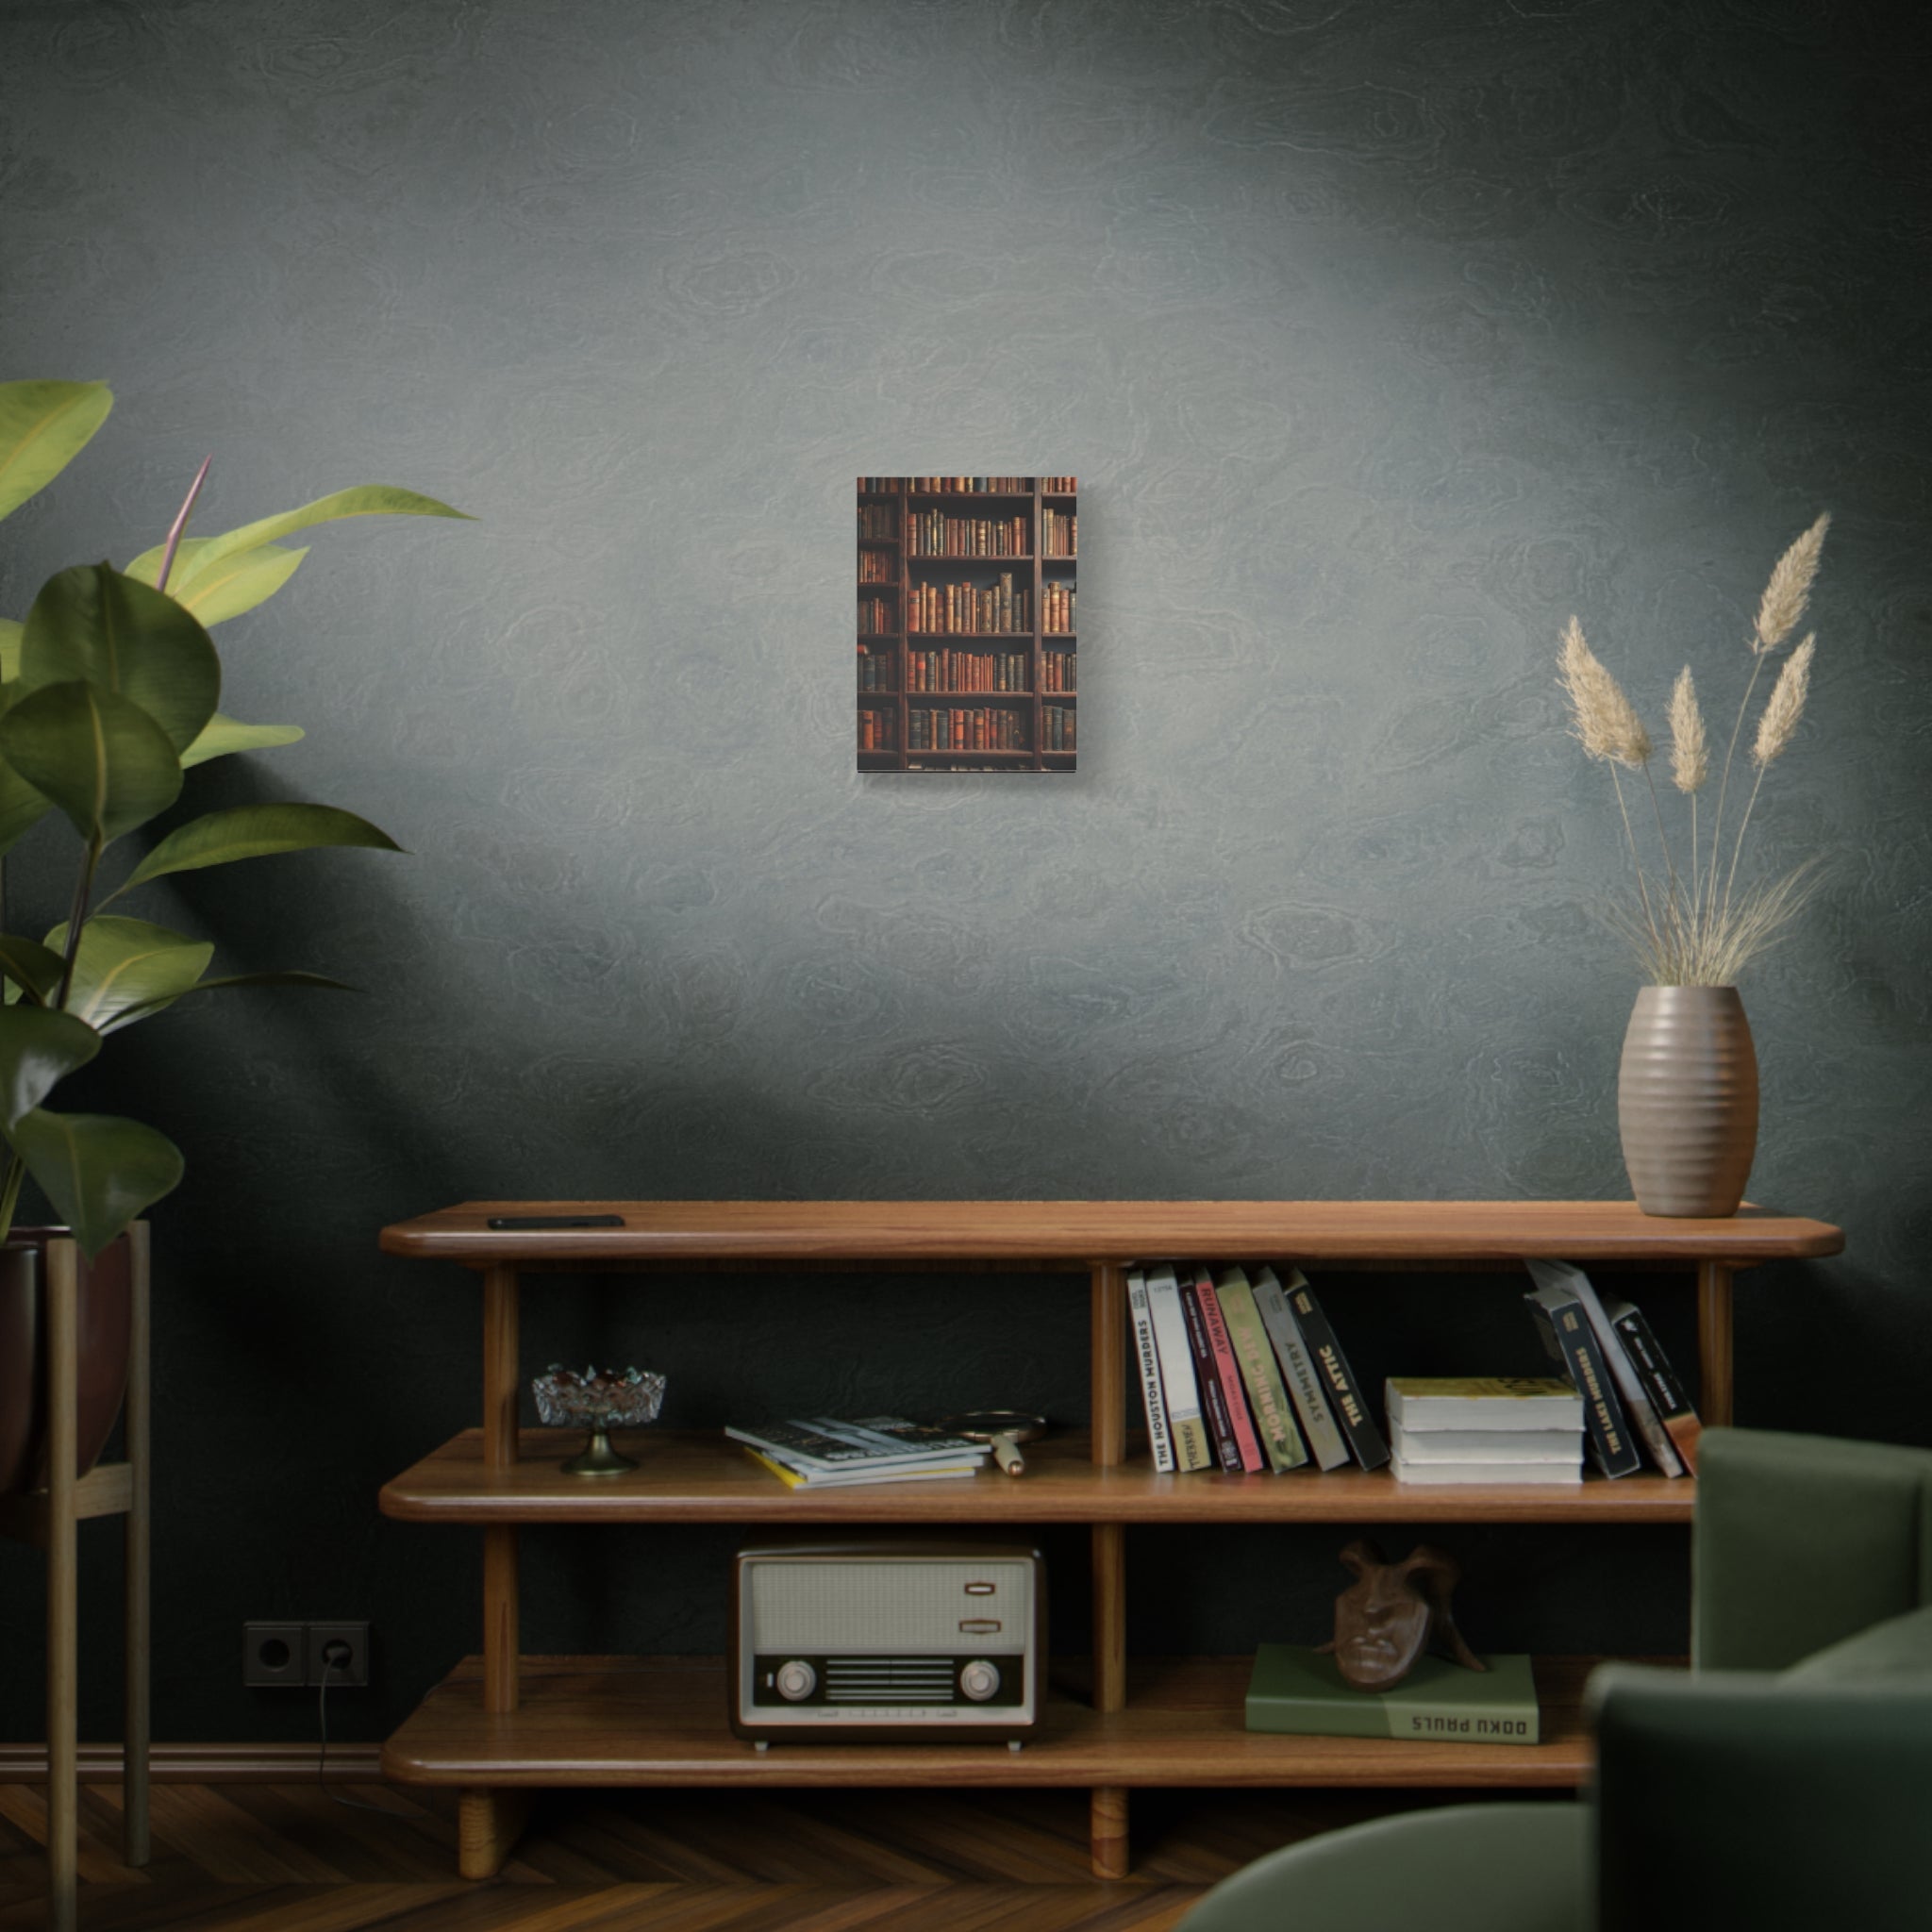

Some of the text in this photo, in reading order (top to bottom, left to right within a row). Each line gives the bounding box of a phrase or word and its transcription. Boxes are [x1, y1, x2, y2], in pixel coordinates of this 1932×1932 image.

[1200, 1288, 1228, 1355] RUNAWAY
[1236, 1324, 1260, 1361] DEW
[1137, 1320, 1168, 1465] THE HOUSTON MURDERS
[1248, 1362, 1287, 1443] MORNING
[1283, 1340, 1325, 1424] SYMMETRY
[1317, 1343, 1364, 1426] THE ATTIC
[1574, 1345, 1623, 1455] THE LAKE MURDERS
[1412, 1716, 1470, 1733] PAULS
